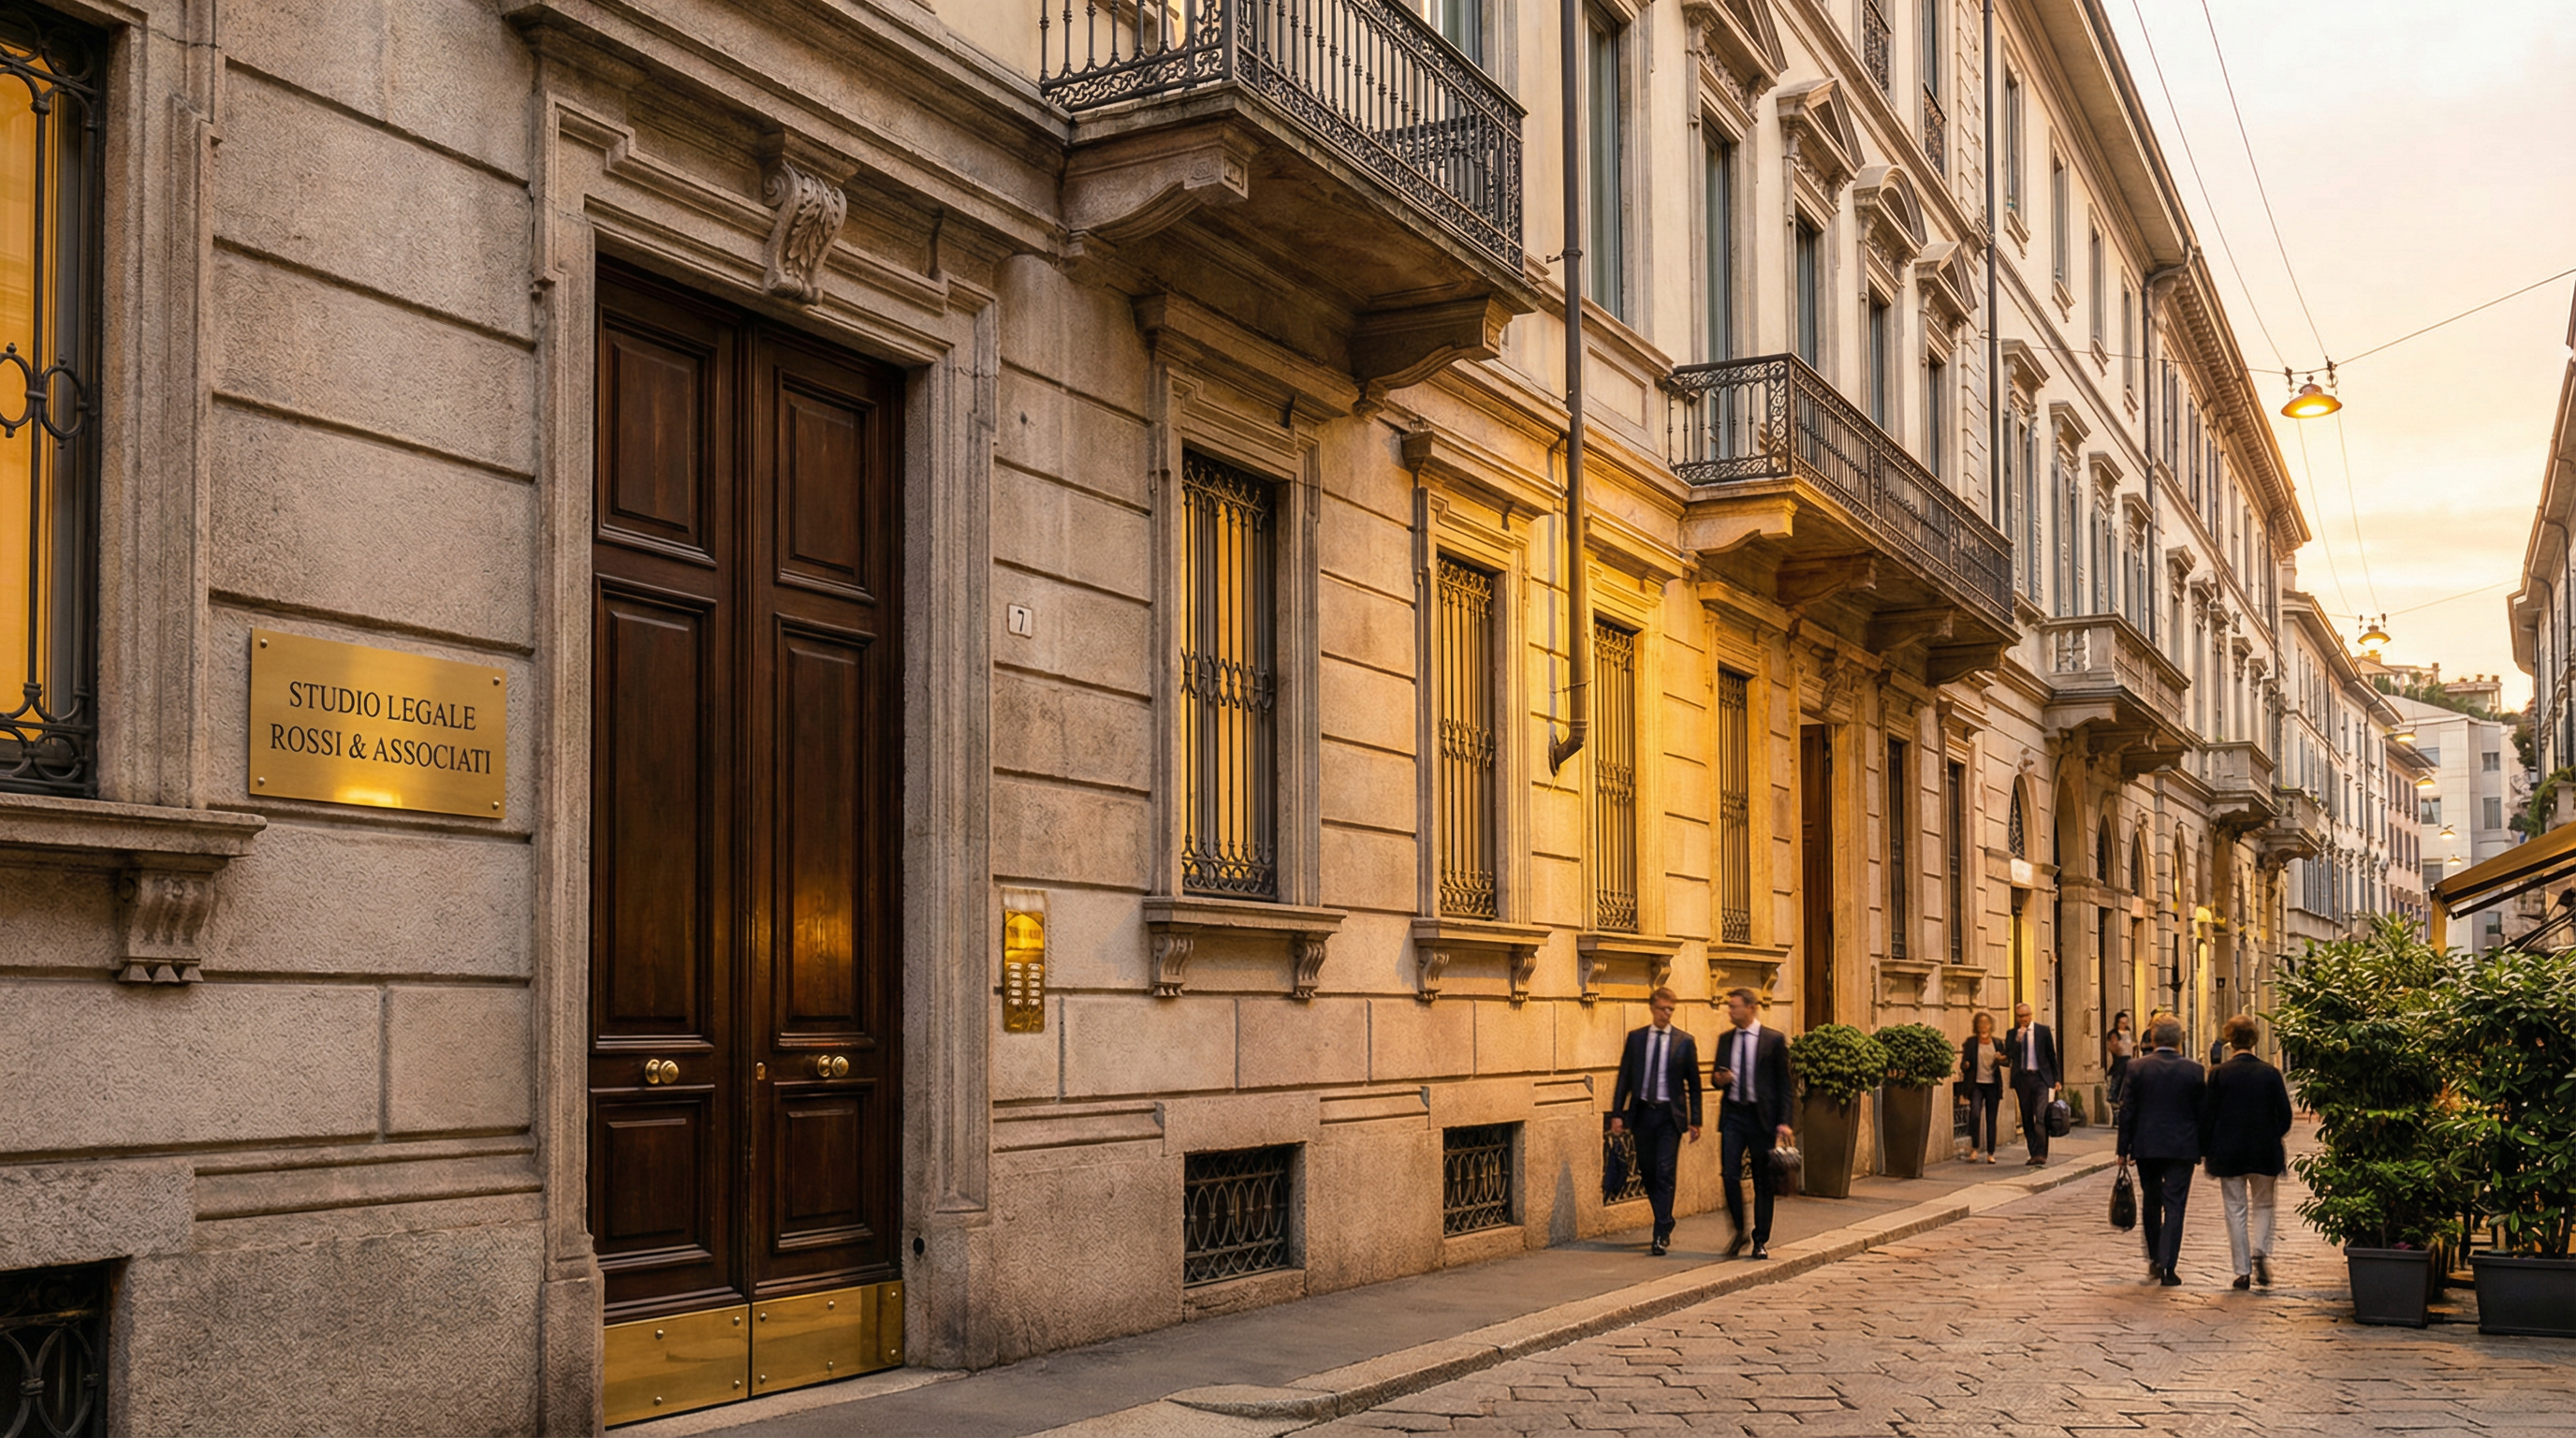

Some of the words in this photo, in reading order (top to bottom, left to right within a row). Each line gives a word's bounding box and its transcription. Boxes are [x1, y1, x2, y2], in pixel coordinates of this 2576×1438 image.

[1017, 609, 1025, 632] 7
[289, 681, 381, 718] STUDIO
[387, 695, 476, 730] LEGALE
[270, 723, 342, 756] ROSSI
[348, 733, 367, 760] &
[373, 737, 491, 774] ASSOCIATI
